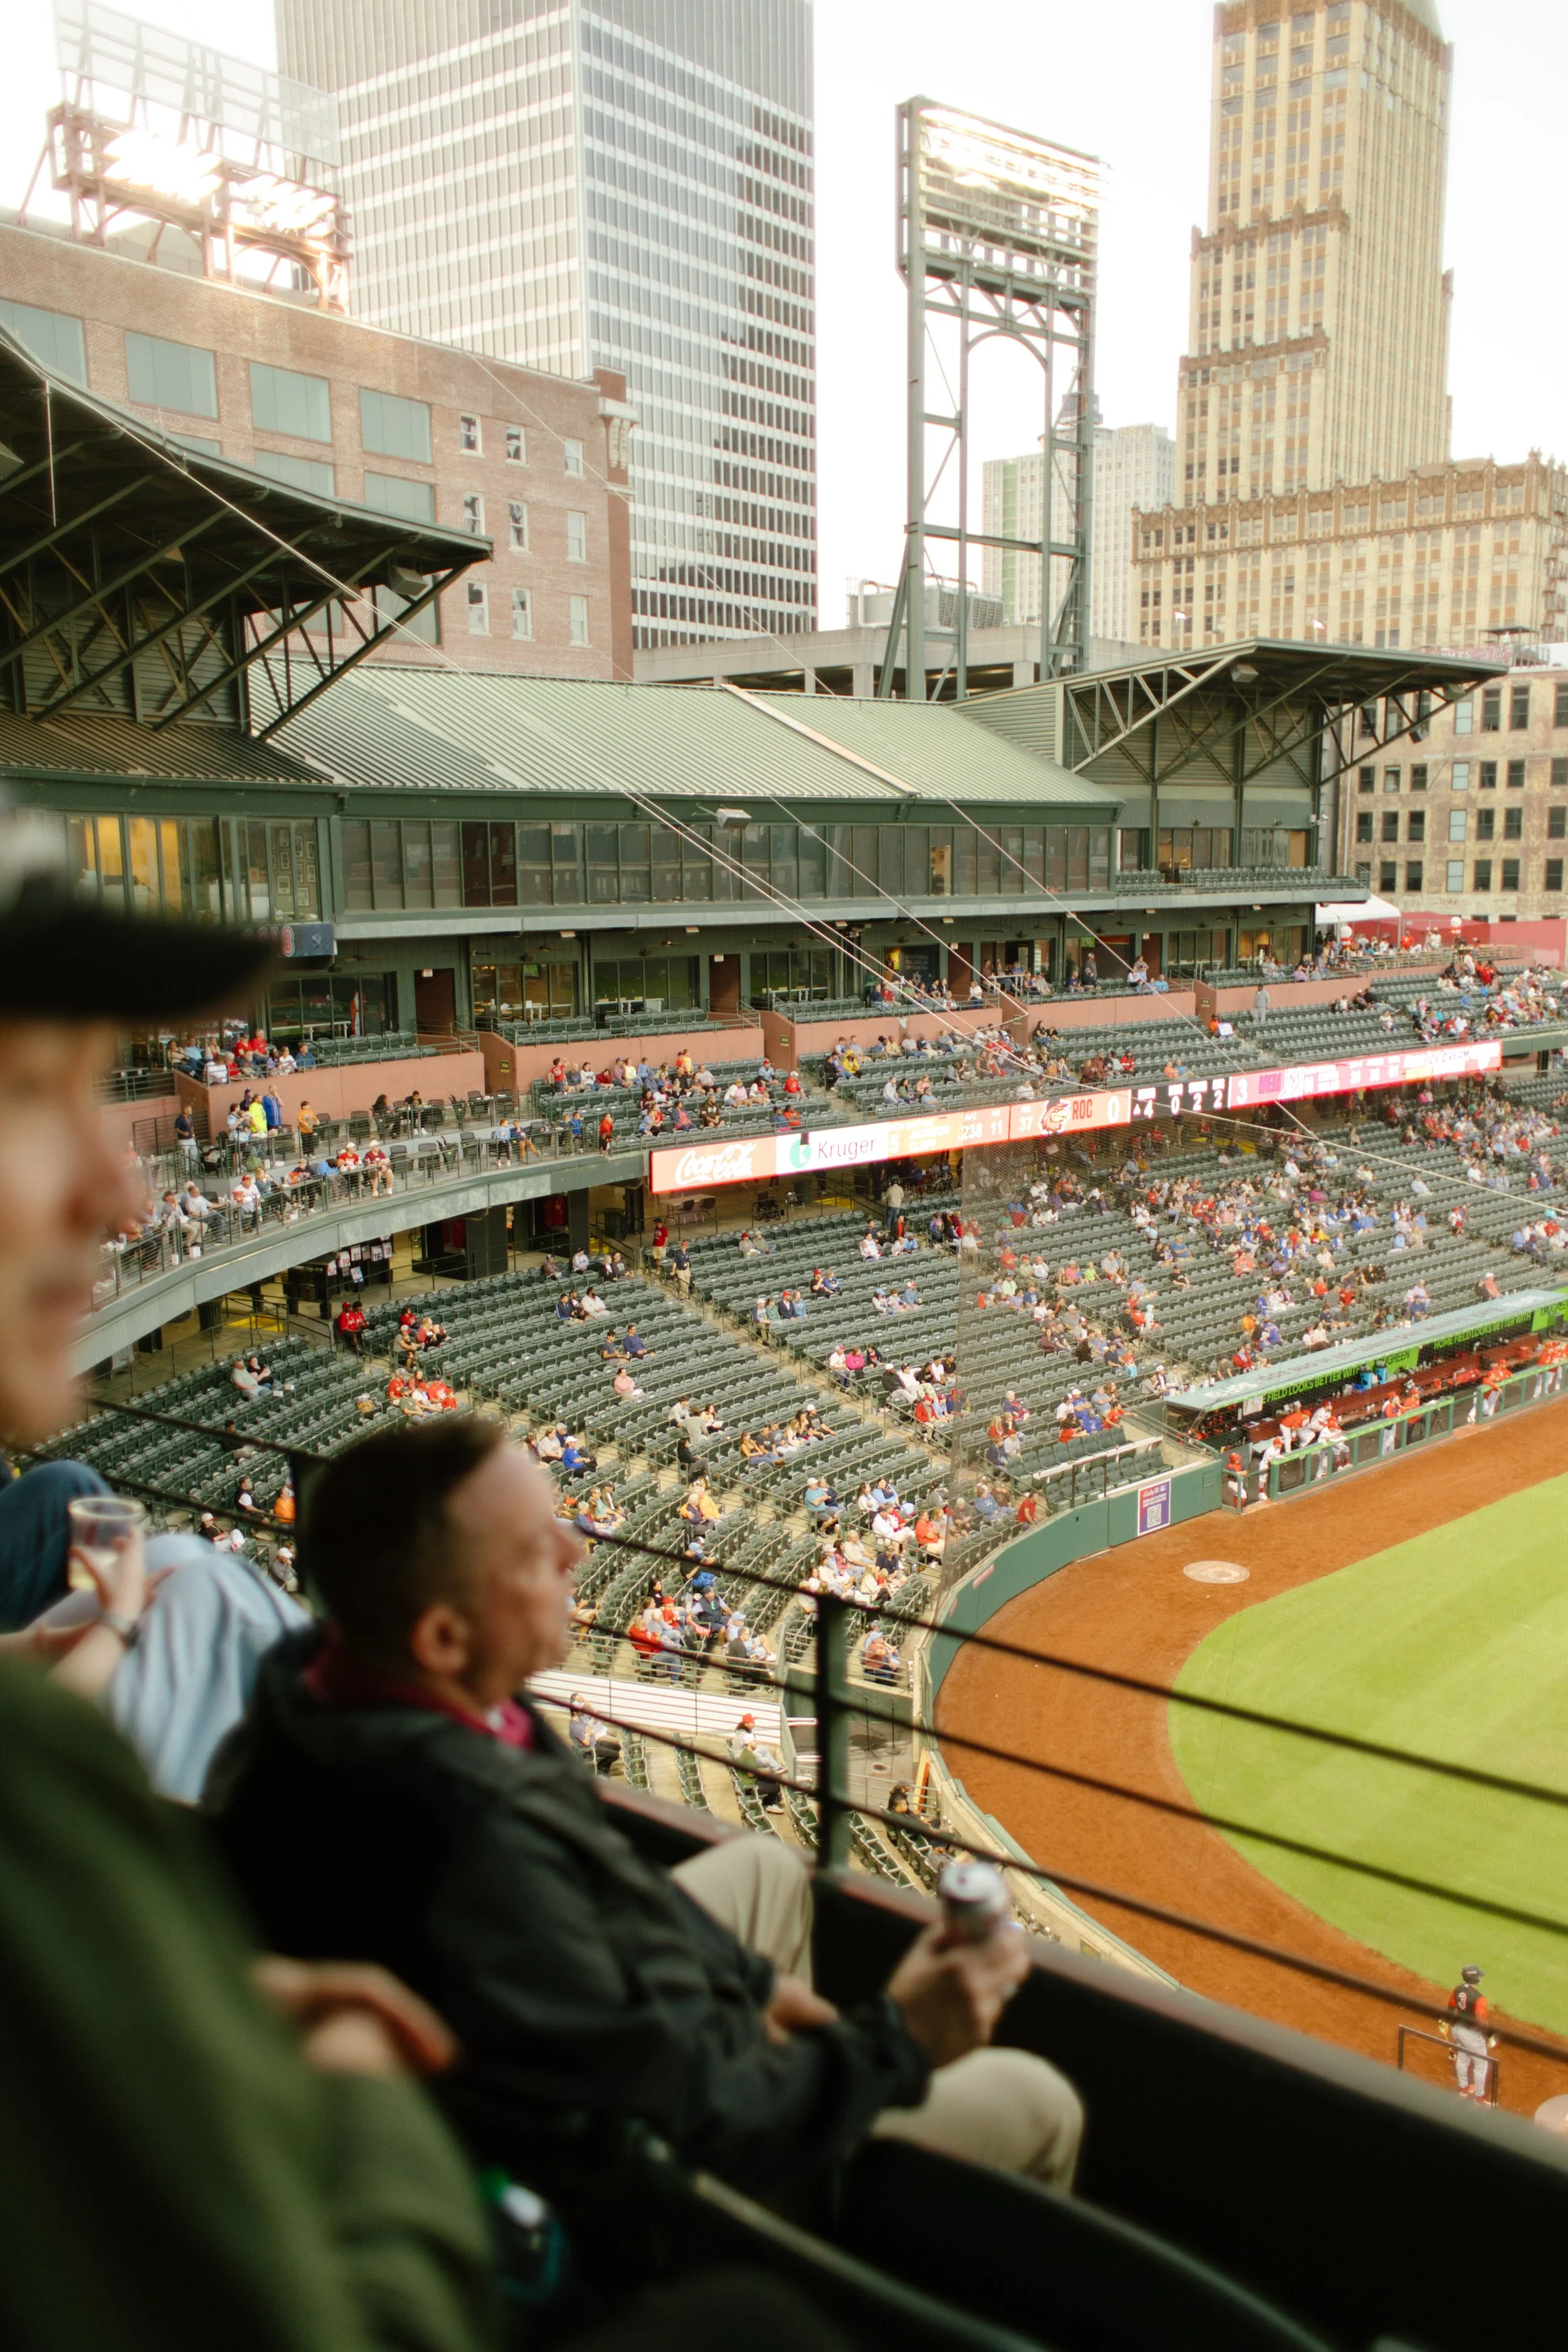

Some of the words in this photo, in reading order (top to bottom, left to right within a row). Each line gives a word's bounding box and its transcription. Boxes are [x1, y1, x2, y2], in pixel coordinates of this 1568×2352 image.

[1236, 1078, 1248, 1104] 3
[1259, 1073, 1281, 1094] MEM
[1072, 1098, 1093, 1121] ROC
[1108, 1095, 1120, 1123] 0
[1145, 1099, 1153, 1118] 4
[1172, 1096, 1180, 1113] 0
[1193, 1093, 1202, 1111] 2
[1214, 1089, 1222, 1108] 2
[990, 1120, 1002, 1136] 11
[1019, 1115, 1034, 1132] 37
[818, 1138, 876, 1160] Kruger
[889, 1133, 900, 1154] 5
[1540, 1300, 1568, 1316] TRUGREE
[1434, 1335, 1454, 1350] HOME
[1454, 1329, 1471, 1343] FIELD
[1471, 1324, 1492, 1338] LOOKS
[1493, 1317, 1514, 1332] BETTER
[1515, 1311, 1531, 1324] WITH
[1377, 1348, 1411, 1365] UGREEN
[1267, 1389, 1287, 1402] FIELD
[1289, 1380, 1313, 1396] LOOKS
[1315, 1371, 1341, 1388] BETTER
